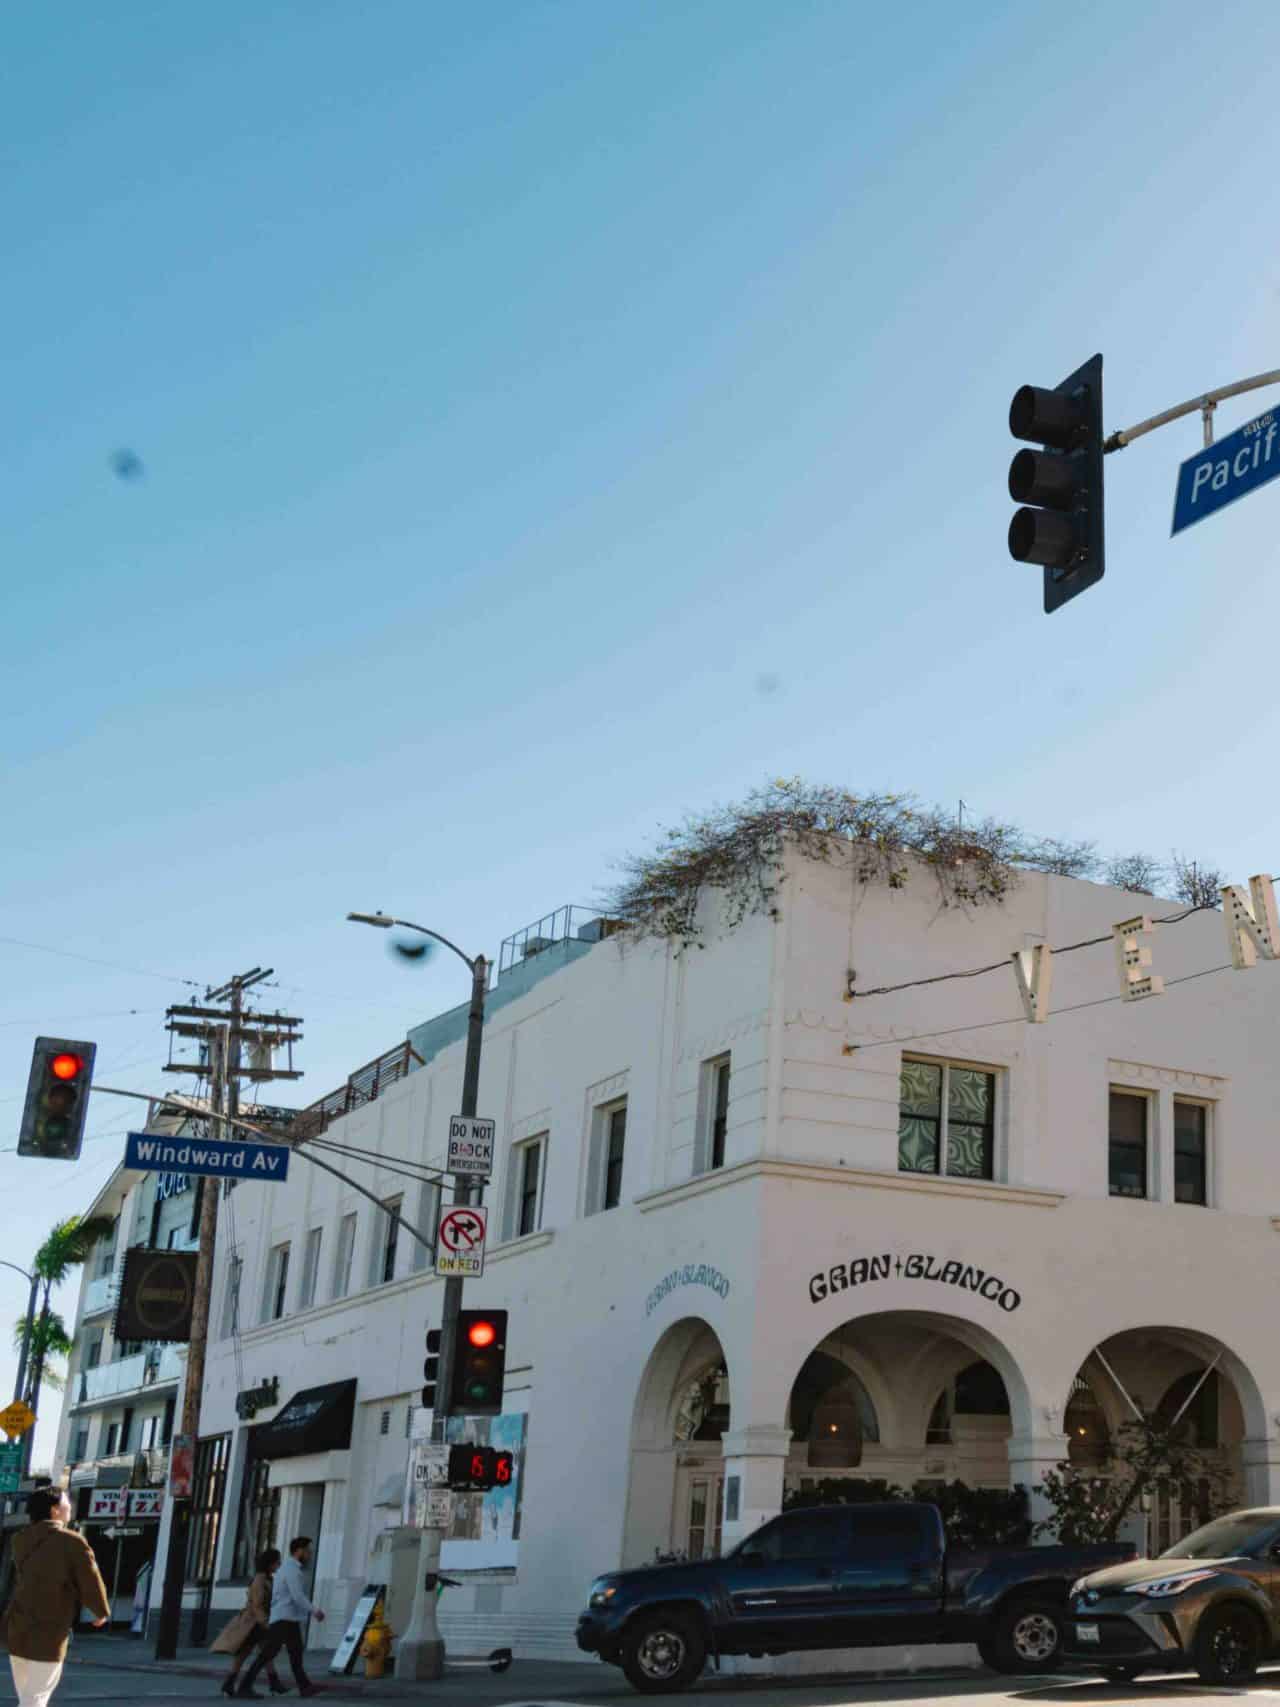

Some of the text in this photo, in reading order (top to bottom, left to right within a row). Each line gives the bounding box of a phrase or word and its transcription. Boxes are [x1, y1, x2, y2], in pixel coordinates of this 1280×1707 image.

[452, 1123, 492, 1140] DO NOT
[136, 1140, 280, 1171] Windward Av
[439, 1256, 480, 1271] ON RED
[809, 1254, 1021, 1312] GRAN BLANCO
[95, 1501, 161, 1513] PIZA
